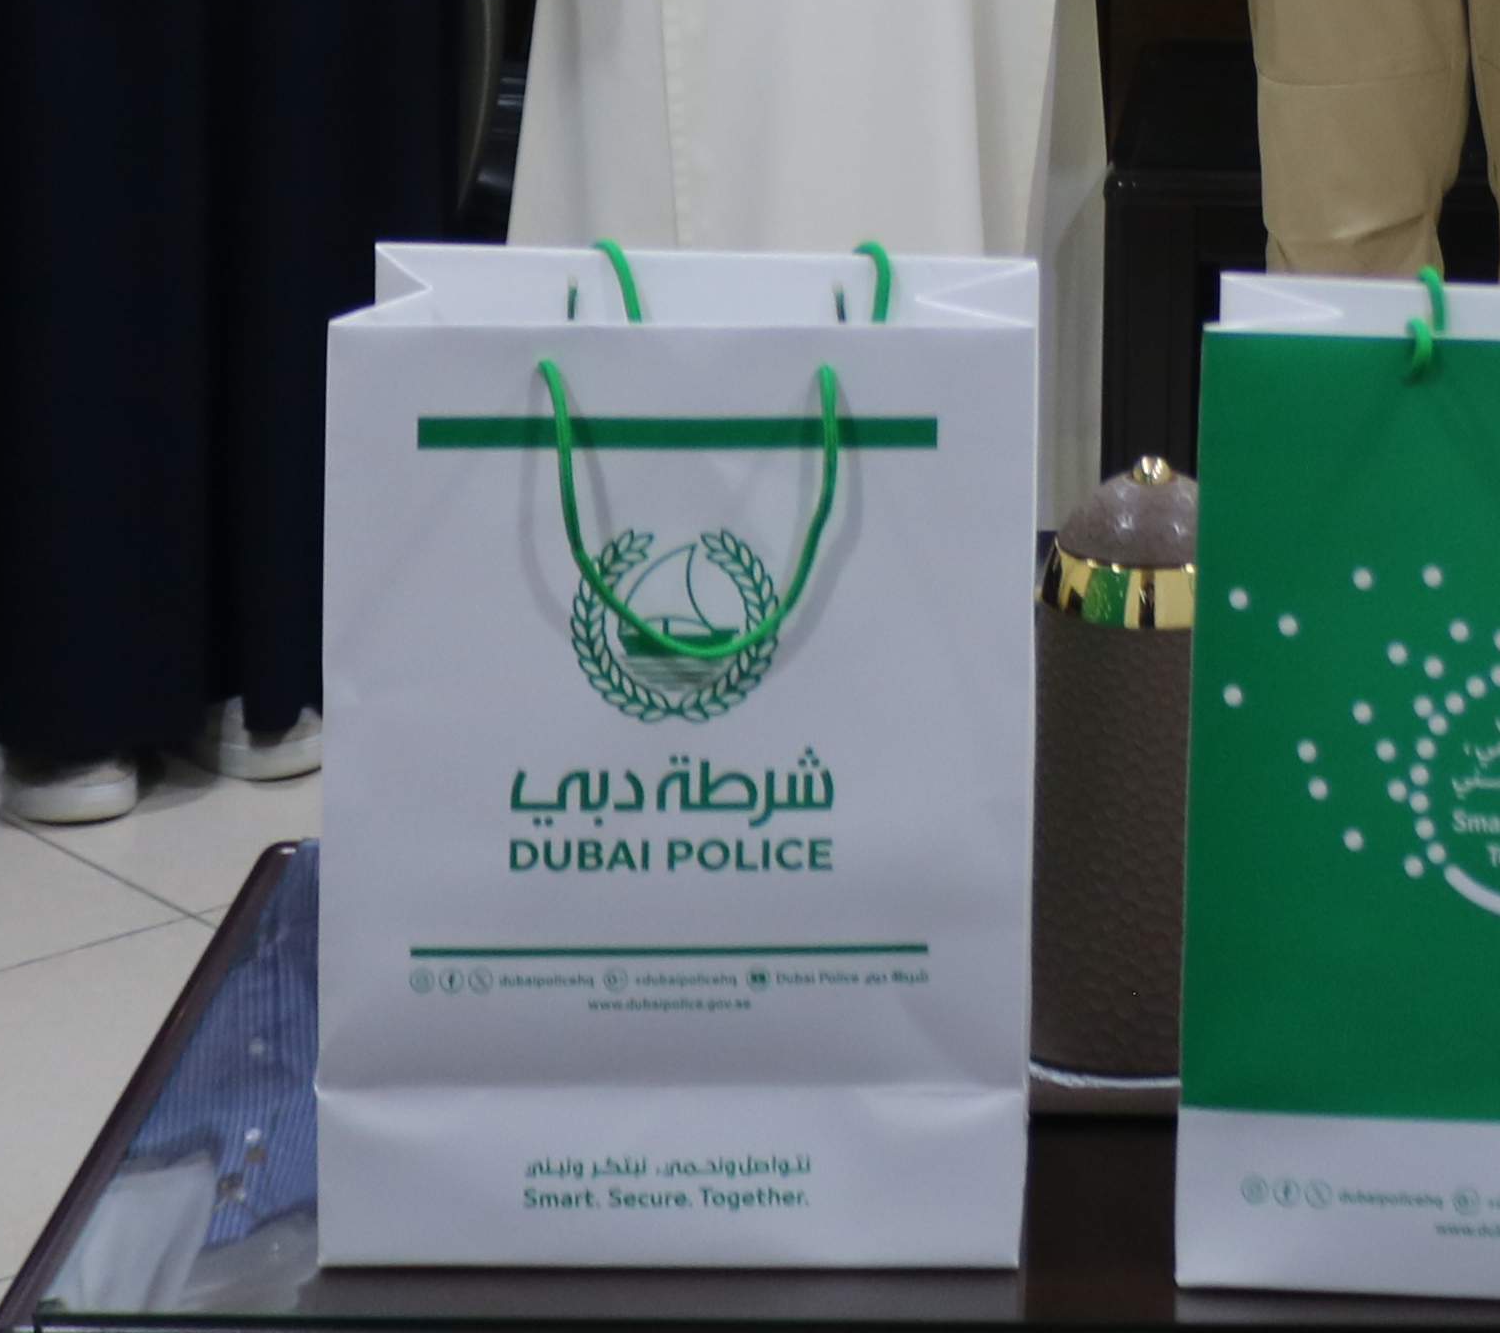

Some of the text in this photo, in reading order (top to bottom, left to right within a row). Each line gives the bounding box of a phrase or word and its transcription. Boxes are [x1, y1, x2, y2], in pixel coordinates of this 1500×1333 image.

[510, 745, 834, 828] شرطة دبي
[509, 838, 833, 872] DUBAI POLICE
[776, 971, 815, 984] Dubai
[819, 971, 859, 985] Police
[524, 1185, 810, 1211] Smart. Secure. Together.
